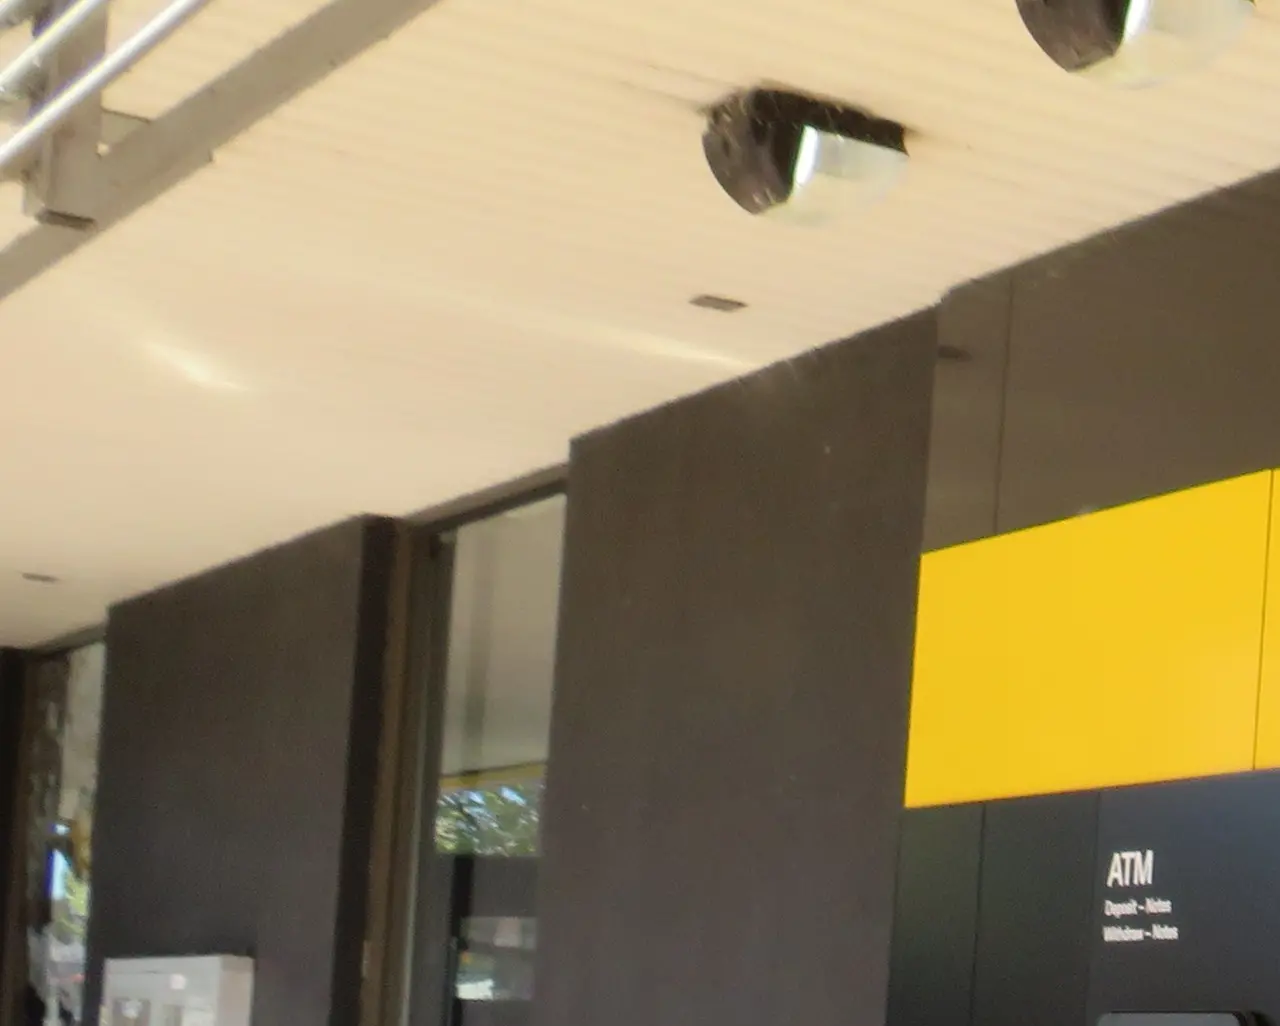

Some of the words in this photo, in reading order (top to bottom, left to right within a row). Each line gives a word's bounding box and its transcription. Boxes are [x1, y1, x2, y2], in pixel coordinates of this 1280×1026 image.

[1106, 849, 1154, 887] ATM
[1104, 898, 1138, 919] Deposit
[1145, 897, 1172, 914] Notes
[1103, 925, 1144, 942] Withdraw
[1152, 923, 1179, 940] Notes
